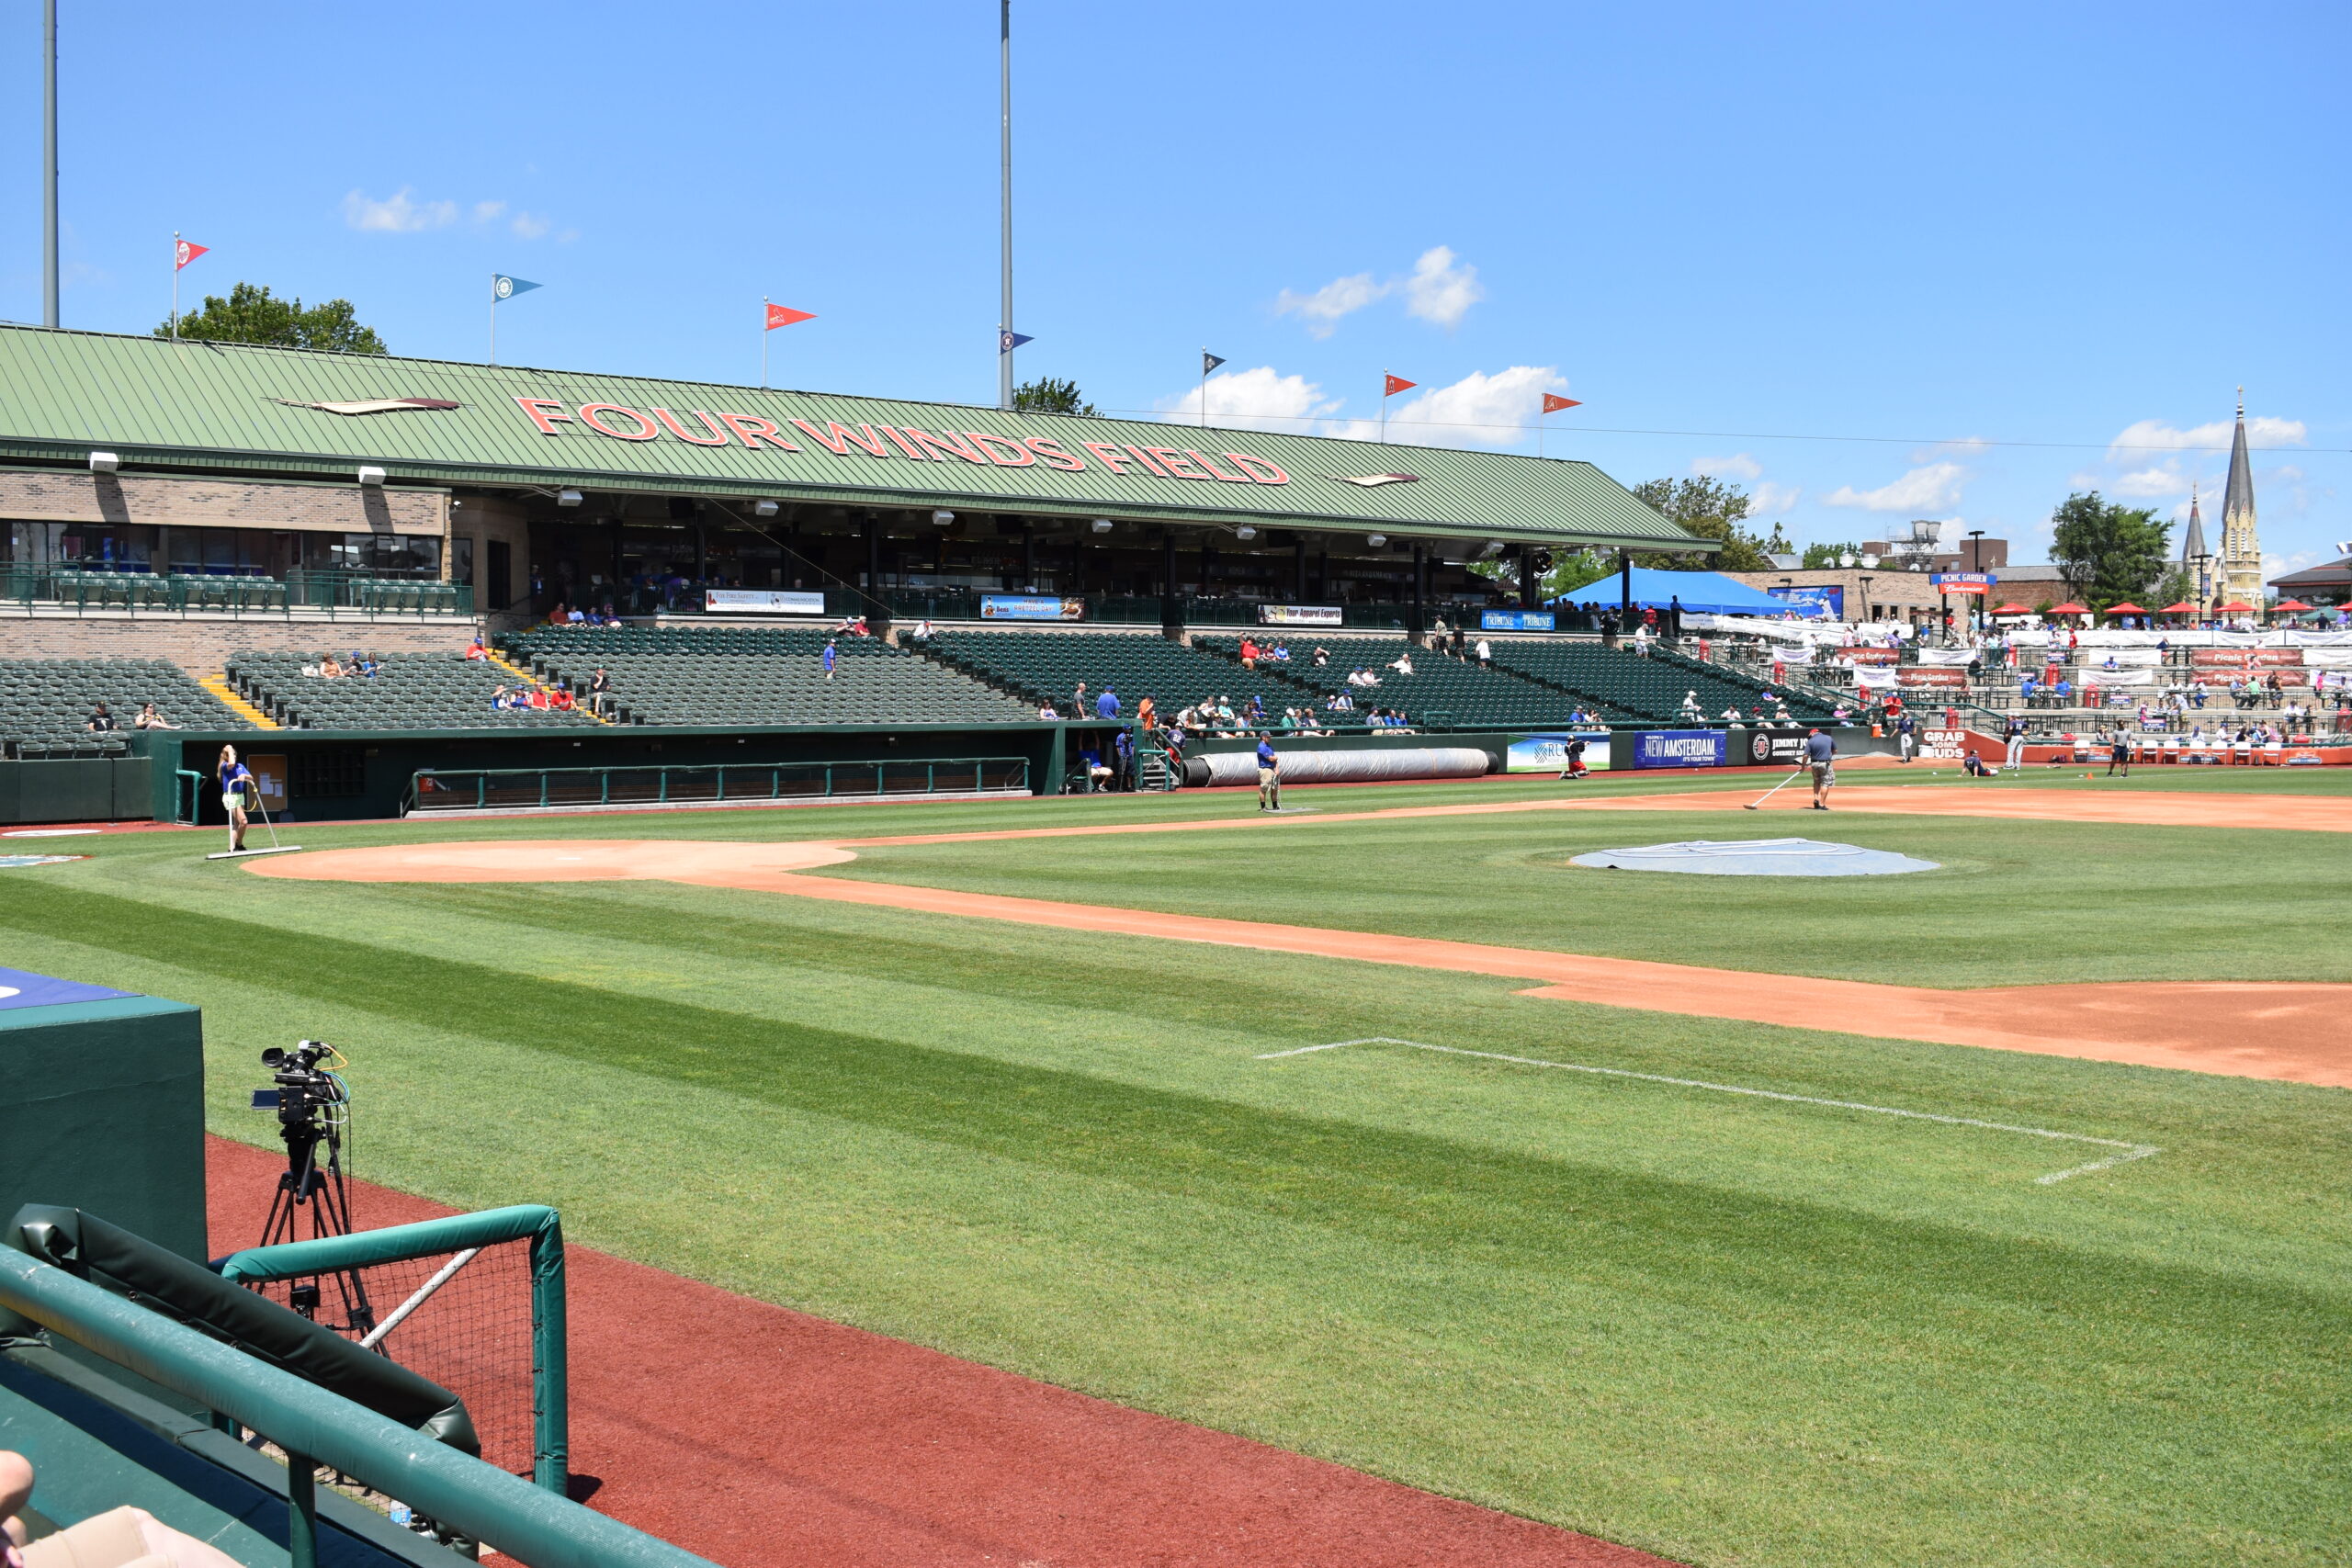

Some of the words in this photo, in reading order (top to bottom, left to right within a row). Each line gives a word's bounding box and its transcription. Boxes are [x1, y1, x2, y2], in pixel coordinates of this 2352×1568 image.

[512, 397, 804, 452] FOUR
[788, 418, 1088, 472] WINDS
[1080, 441, 1290, 486] FIELD
[1940, 573, 1962, 582] PICNIC
[1962, 573, 1987, 582] GARDEN
[1944, 583, 1983, 592] Budweiser
[1286, 607, 1298, 617] Your
[1299, 608, 1320, 619] Apparel
[1320, 609, 1340, 619] Experts
[1485, 616, 1514, 626] TRIBUNE
[1522, 616, 1551, 627] TRIBUNE
[2245, 653, 2278, 661] Grden
[1911, 671, 1928, 680] Picnic
[1928, 672, 1949, 681] Garden
[1172, 733, 1182, 743] 22
[1924, 731, 1965, 742] GRAB
[1645, 739, 1664, 757] NEW
[1663, 739, 1715, 758] AMSTERDAM
[1772, 738, 1798, 750] JIMMY
